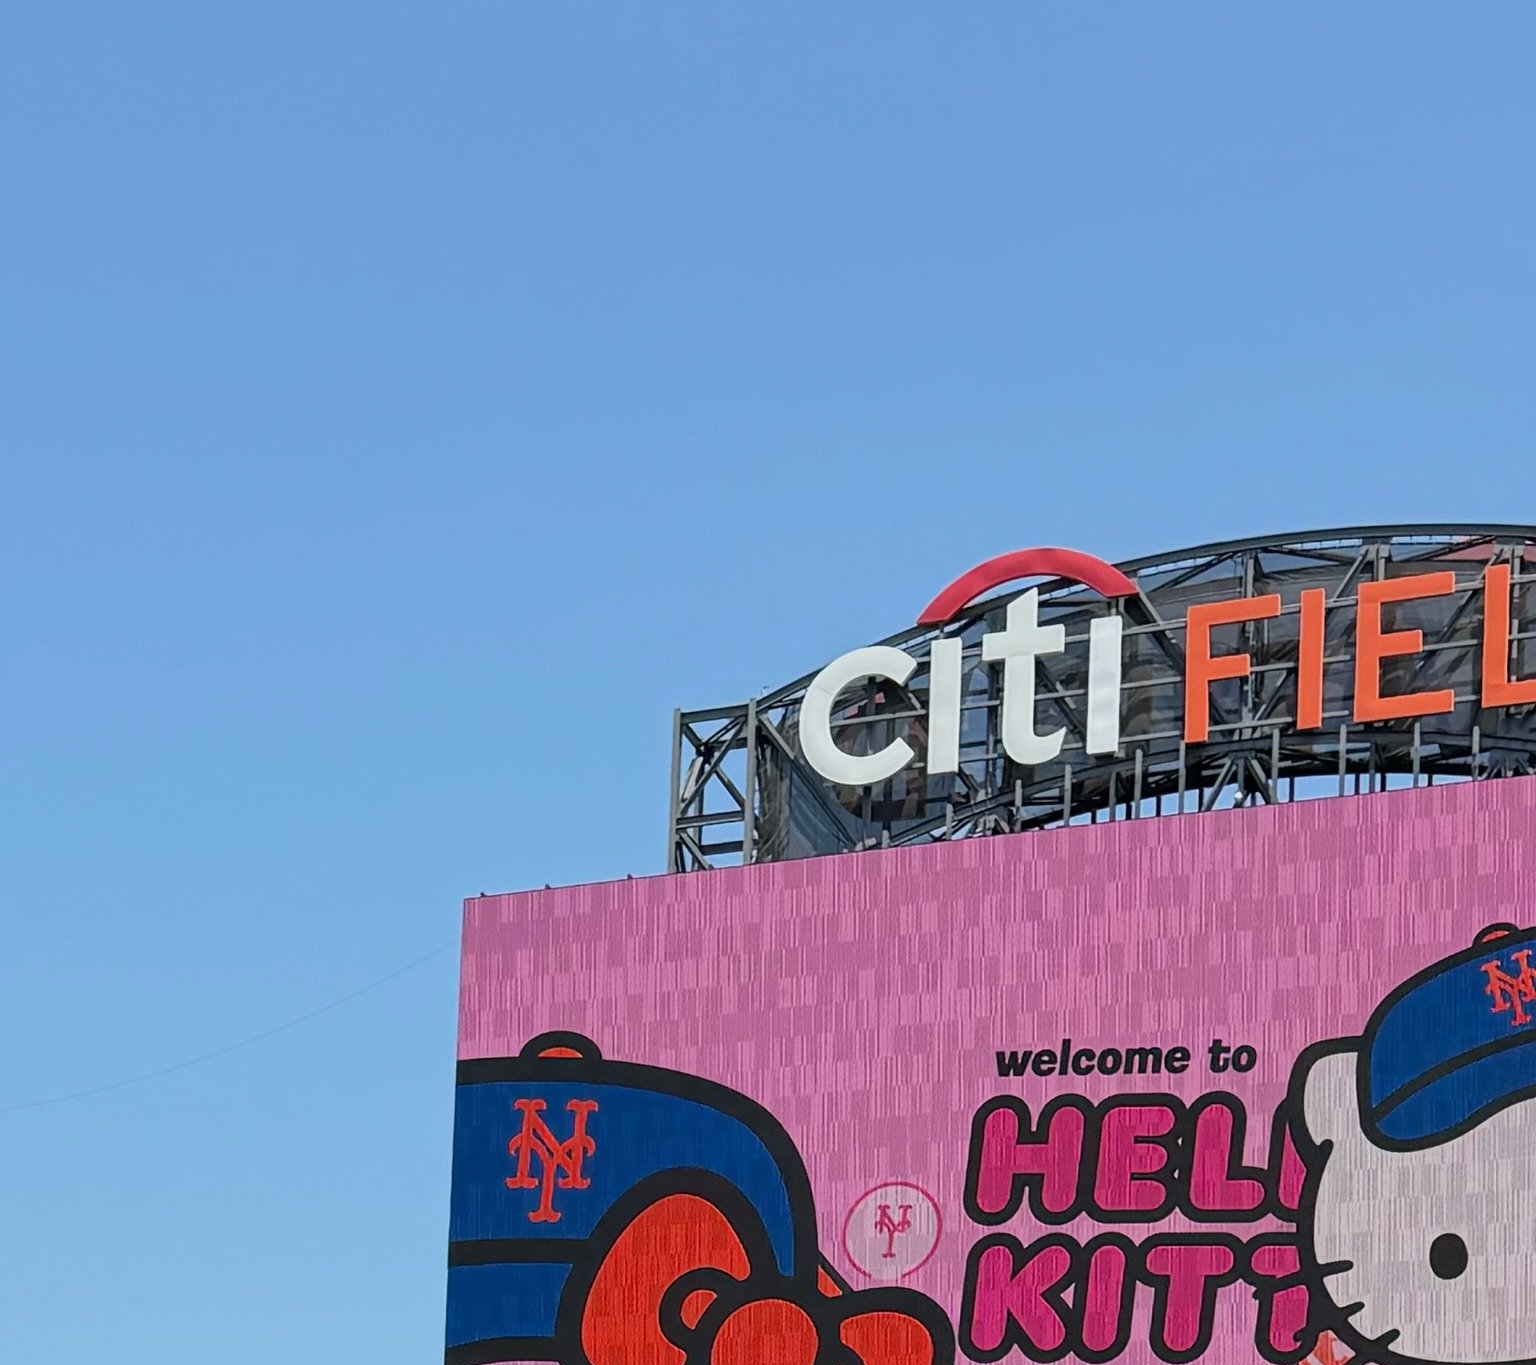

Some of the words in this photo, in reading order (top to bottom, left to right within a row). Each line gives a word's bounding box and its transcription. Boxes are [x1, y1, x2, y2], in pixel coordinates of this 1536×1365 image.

[799, 587, 1123, 786] citi
[996, 1039, 1190, 1077] welcome
[1208, 1039, 1257, 1073] to
[964, 1091, 1306, 1225] HEL
